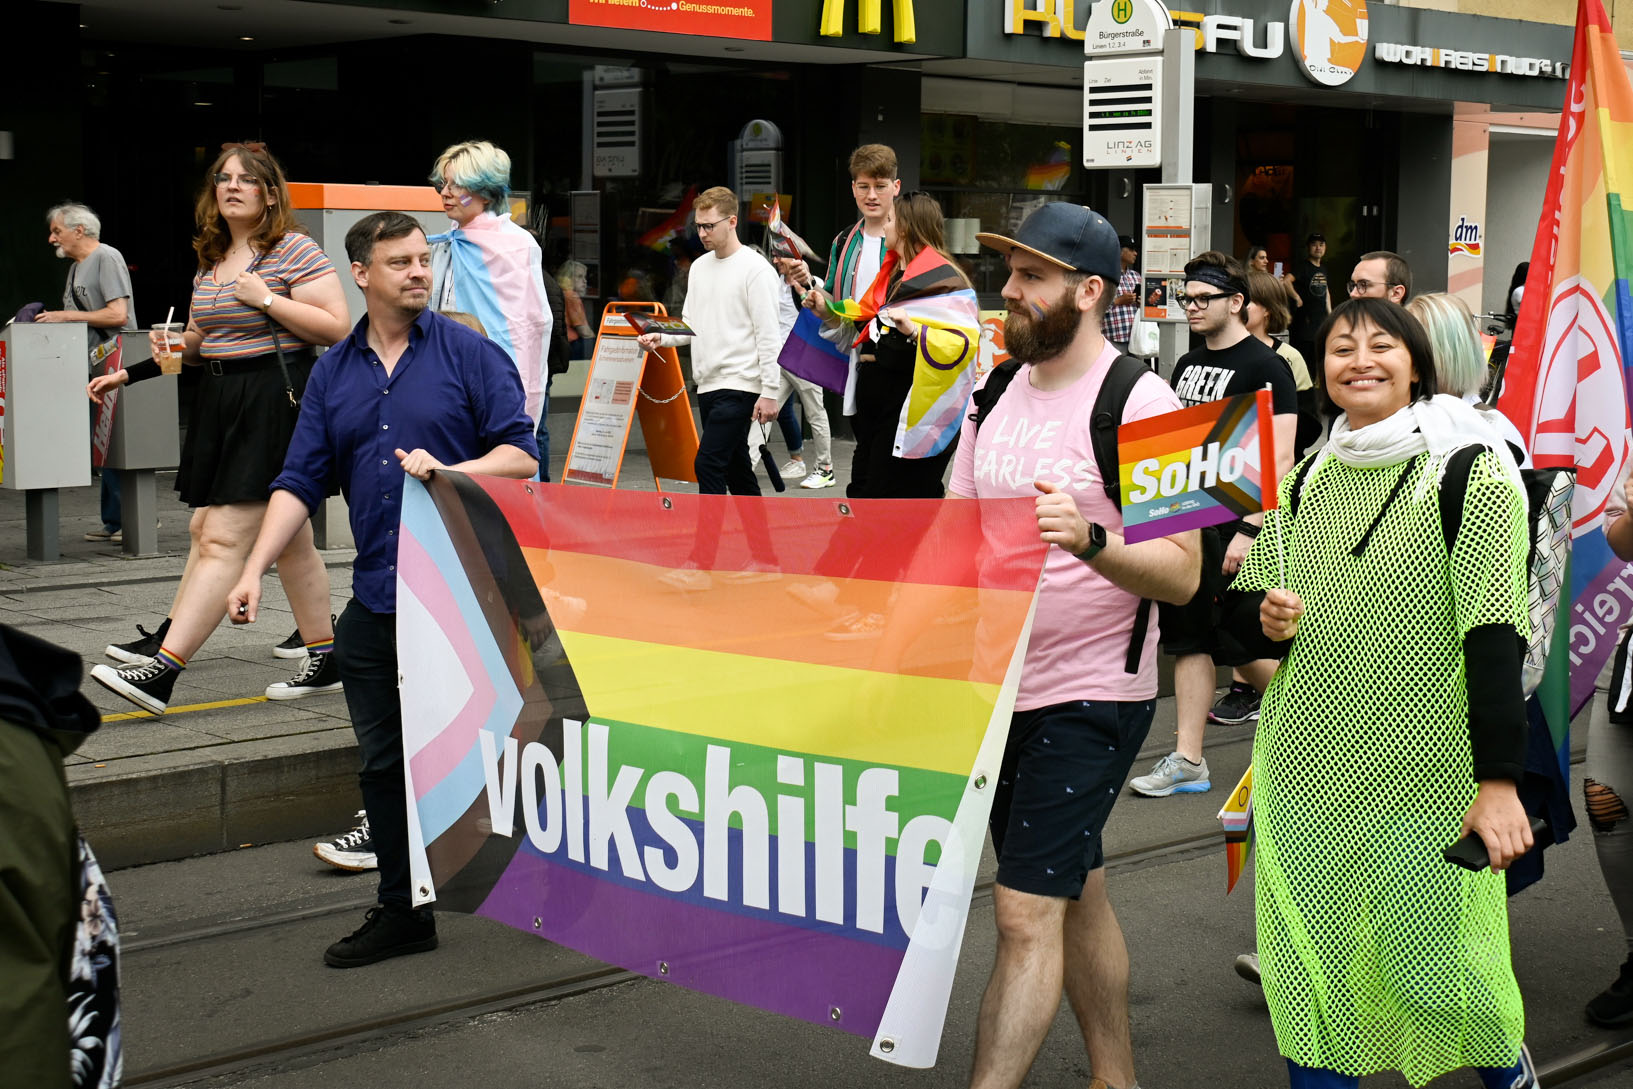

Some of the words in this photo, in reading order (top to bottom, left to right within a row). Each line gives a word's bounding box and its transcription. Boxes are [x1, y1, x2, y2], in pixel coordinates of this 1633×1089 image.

[679, 1, 755, 17] Genussmomente.
[1099, 28, 1145, 40] Bürgerstraße
[1203, 15, 1285, 59] FU
[1439, 50, 1490, 72] REIS
[1135, 140, 1152, 148] AG
[1455, 217, 1478, 241] dm
[1176, 365, 1236, 403] GREEN
[991, 415, 1064, 450] LIVE
[975, 447, 1093, 491] EARLESS
[1129, 441, 1246, 504] SoHo
[1148, 505, 1169, 518] SoHo
[479, 717, 960, 943] volkshilfe
